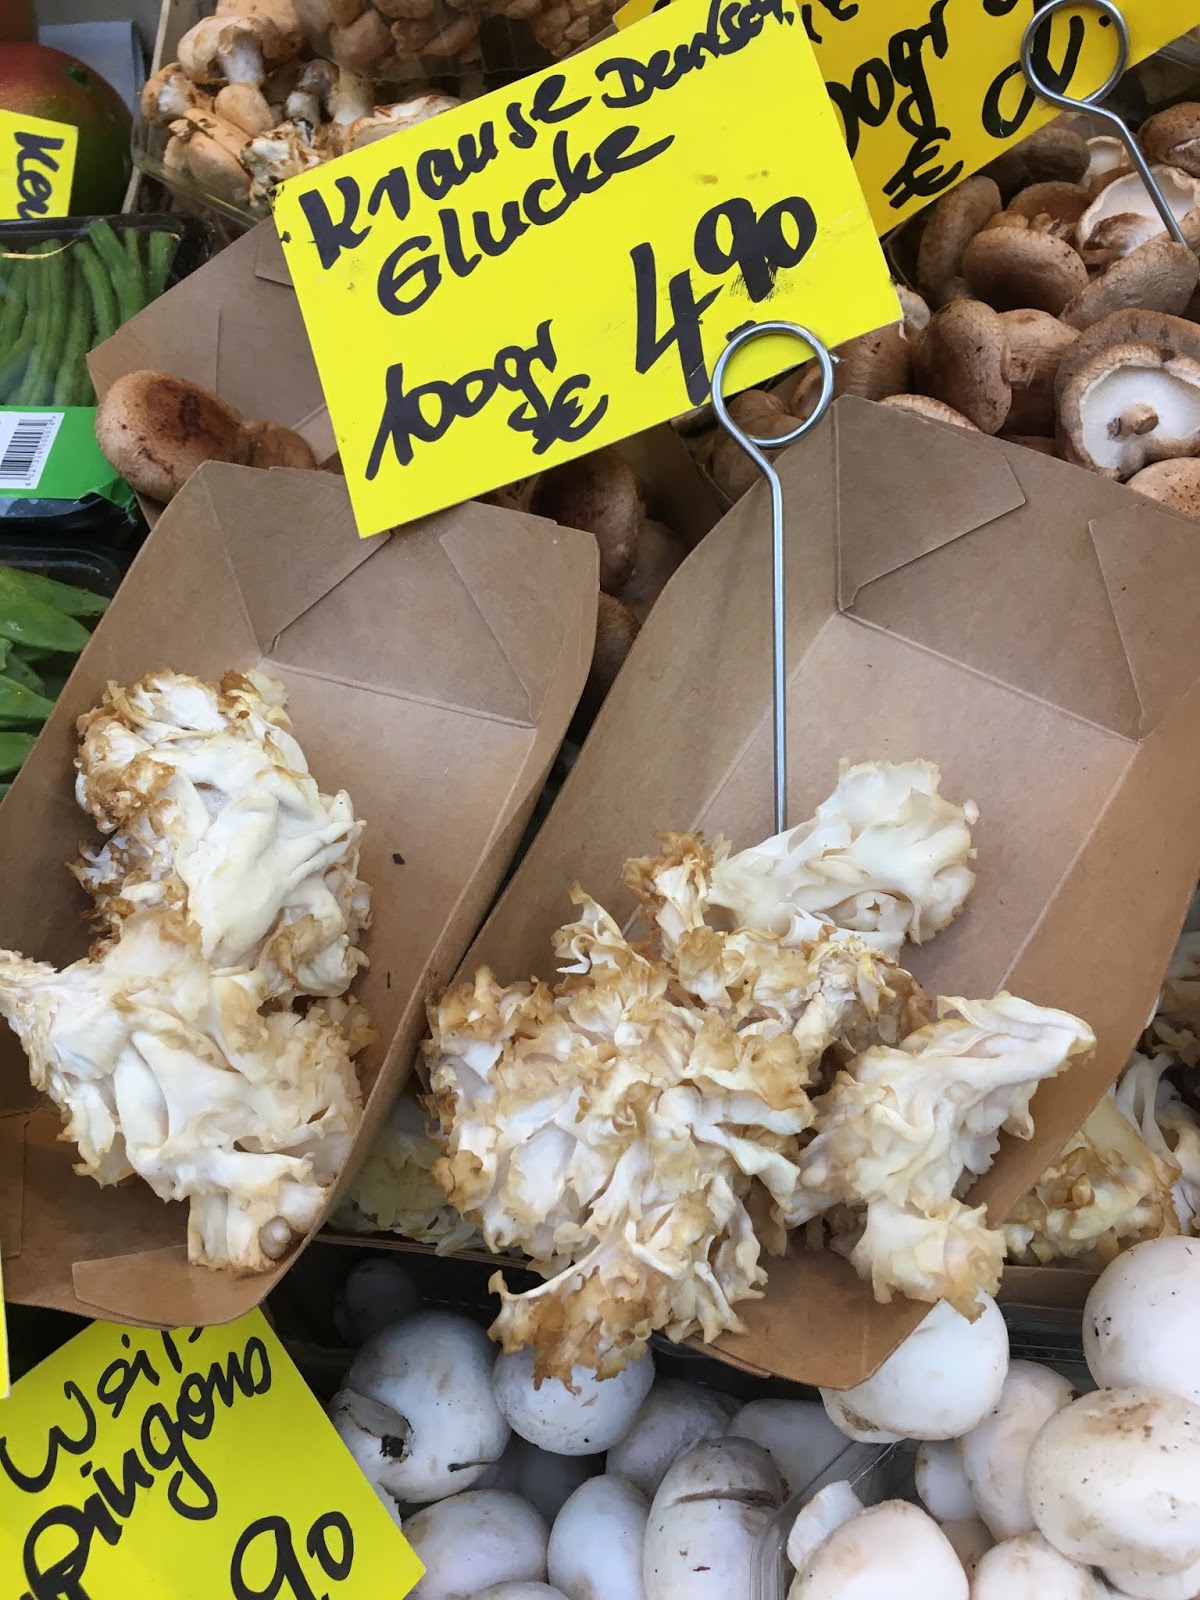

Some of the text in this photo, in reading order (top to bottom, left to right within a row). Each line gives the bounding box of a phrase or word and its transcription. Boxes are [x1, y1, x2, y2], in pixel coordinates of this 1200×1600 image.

[824, 0, 949, 160] 00gr
[299, 74, 592, 270] Krause
[376, 125, 676, 316] Glucke
[364, 318, 558, 482] 100gr
